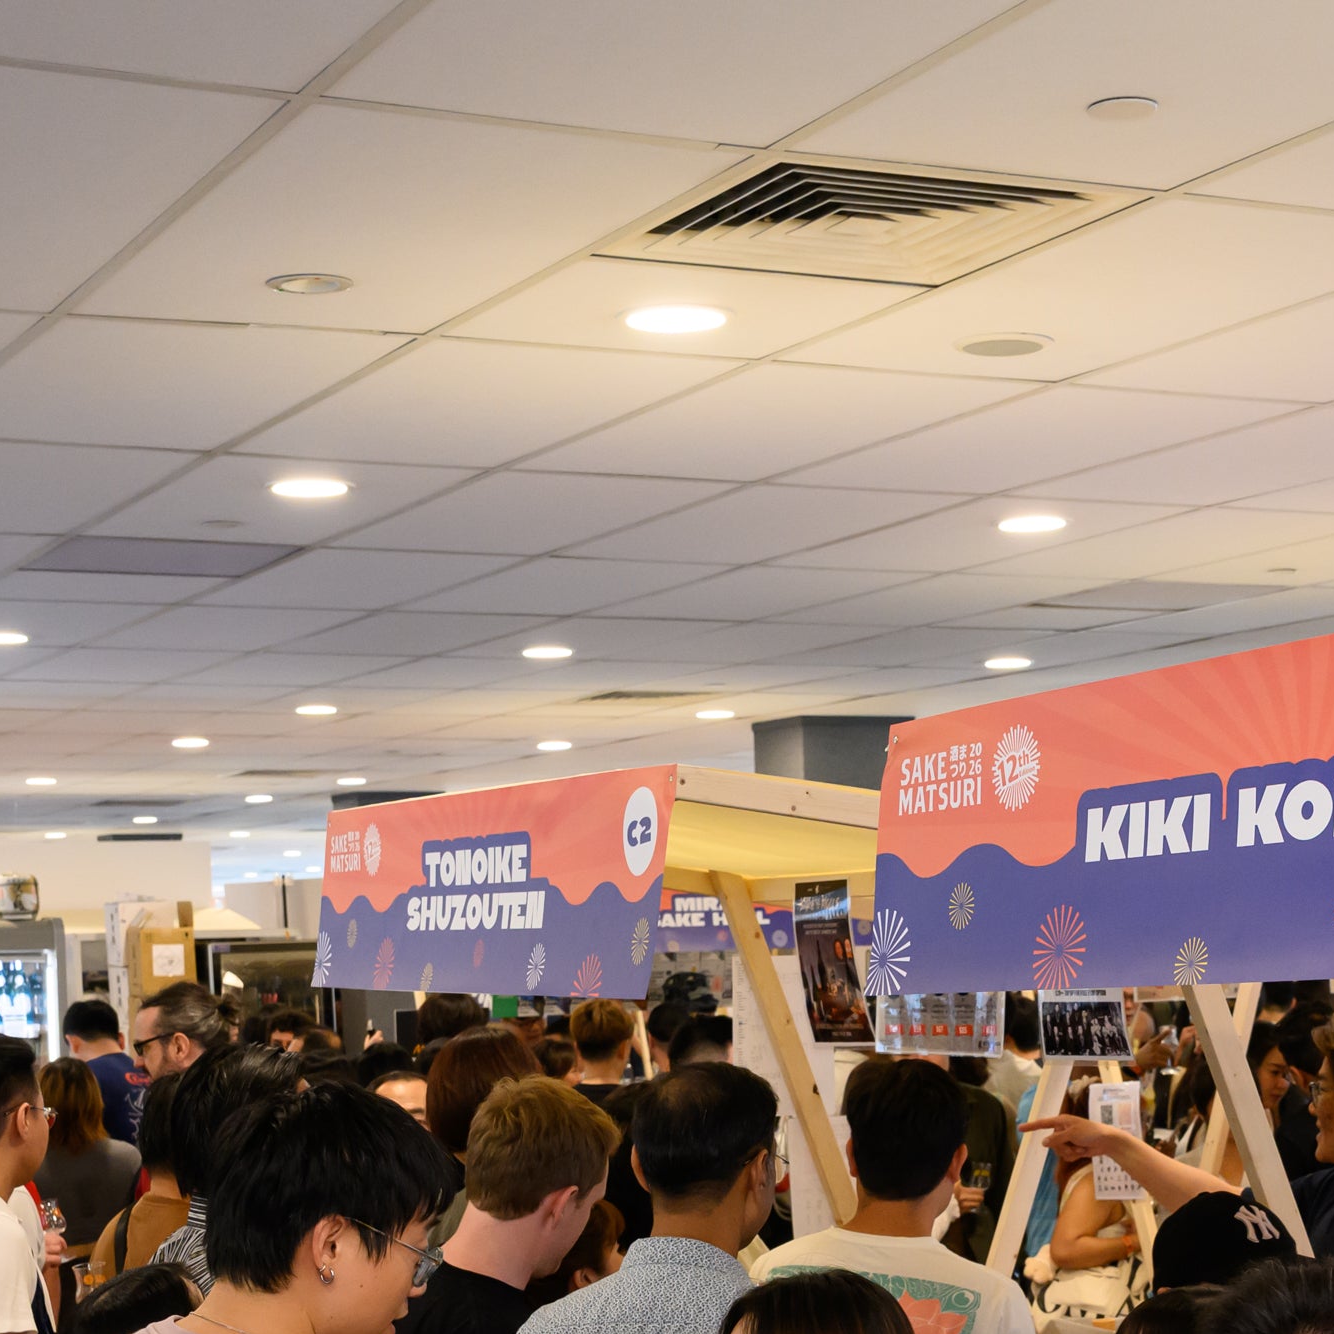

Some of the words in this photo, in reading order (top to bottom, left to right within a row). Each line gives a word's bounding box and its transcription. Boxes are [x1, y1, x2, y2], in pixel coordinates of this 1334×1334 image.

[969, 742, 982, 757] 20
[900, 751, 947, 786] SAKE
[950, 761, 967, 778] つり
[968, 758, 982, 776] 26
[898, 776, 982, 816] MATSURI
[627, 816, 652, 847] C2
[1084, 792, 1212, 862] KIKI
[331, 834, 348, 855] SAKE
[331, 853, 361, 873] MATSURI
[425, 844, 527, 888] TONOIKE
[406, 890, 546, 931] SHUZOUTEN
[658, 911, 706, 927] AKE
